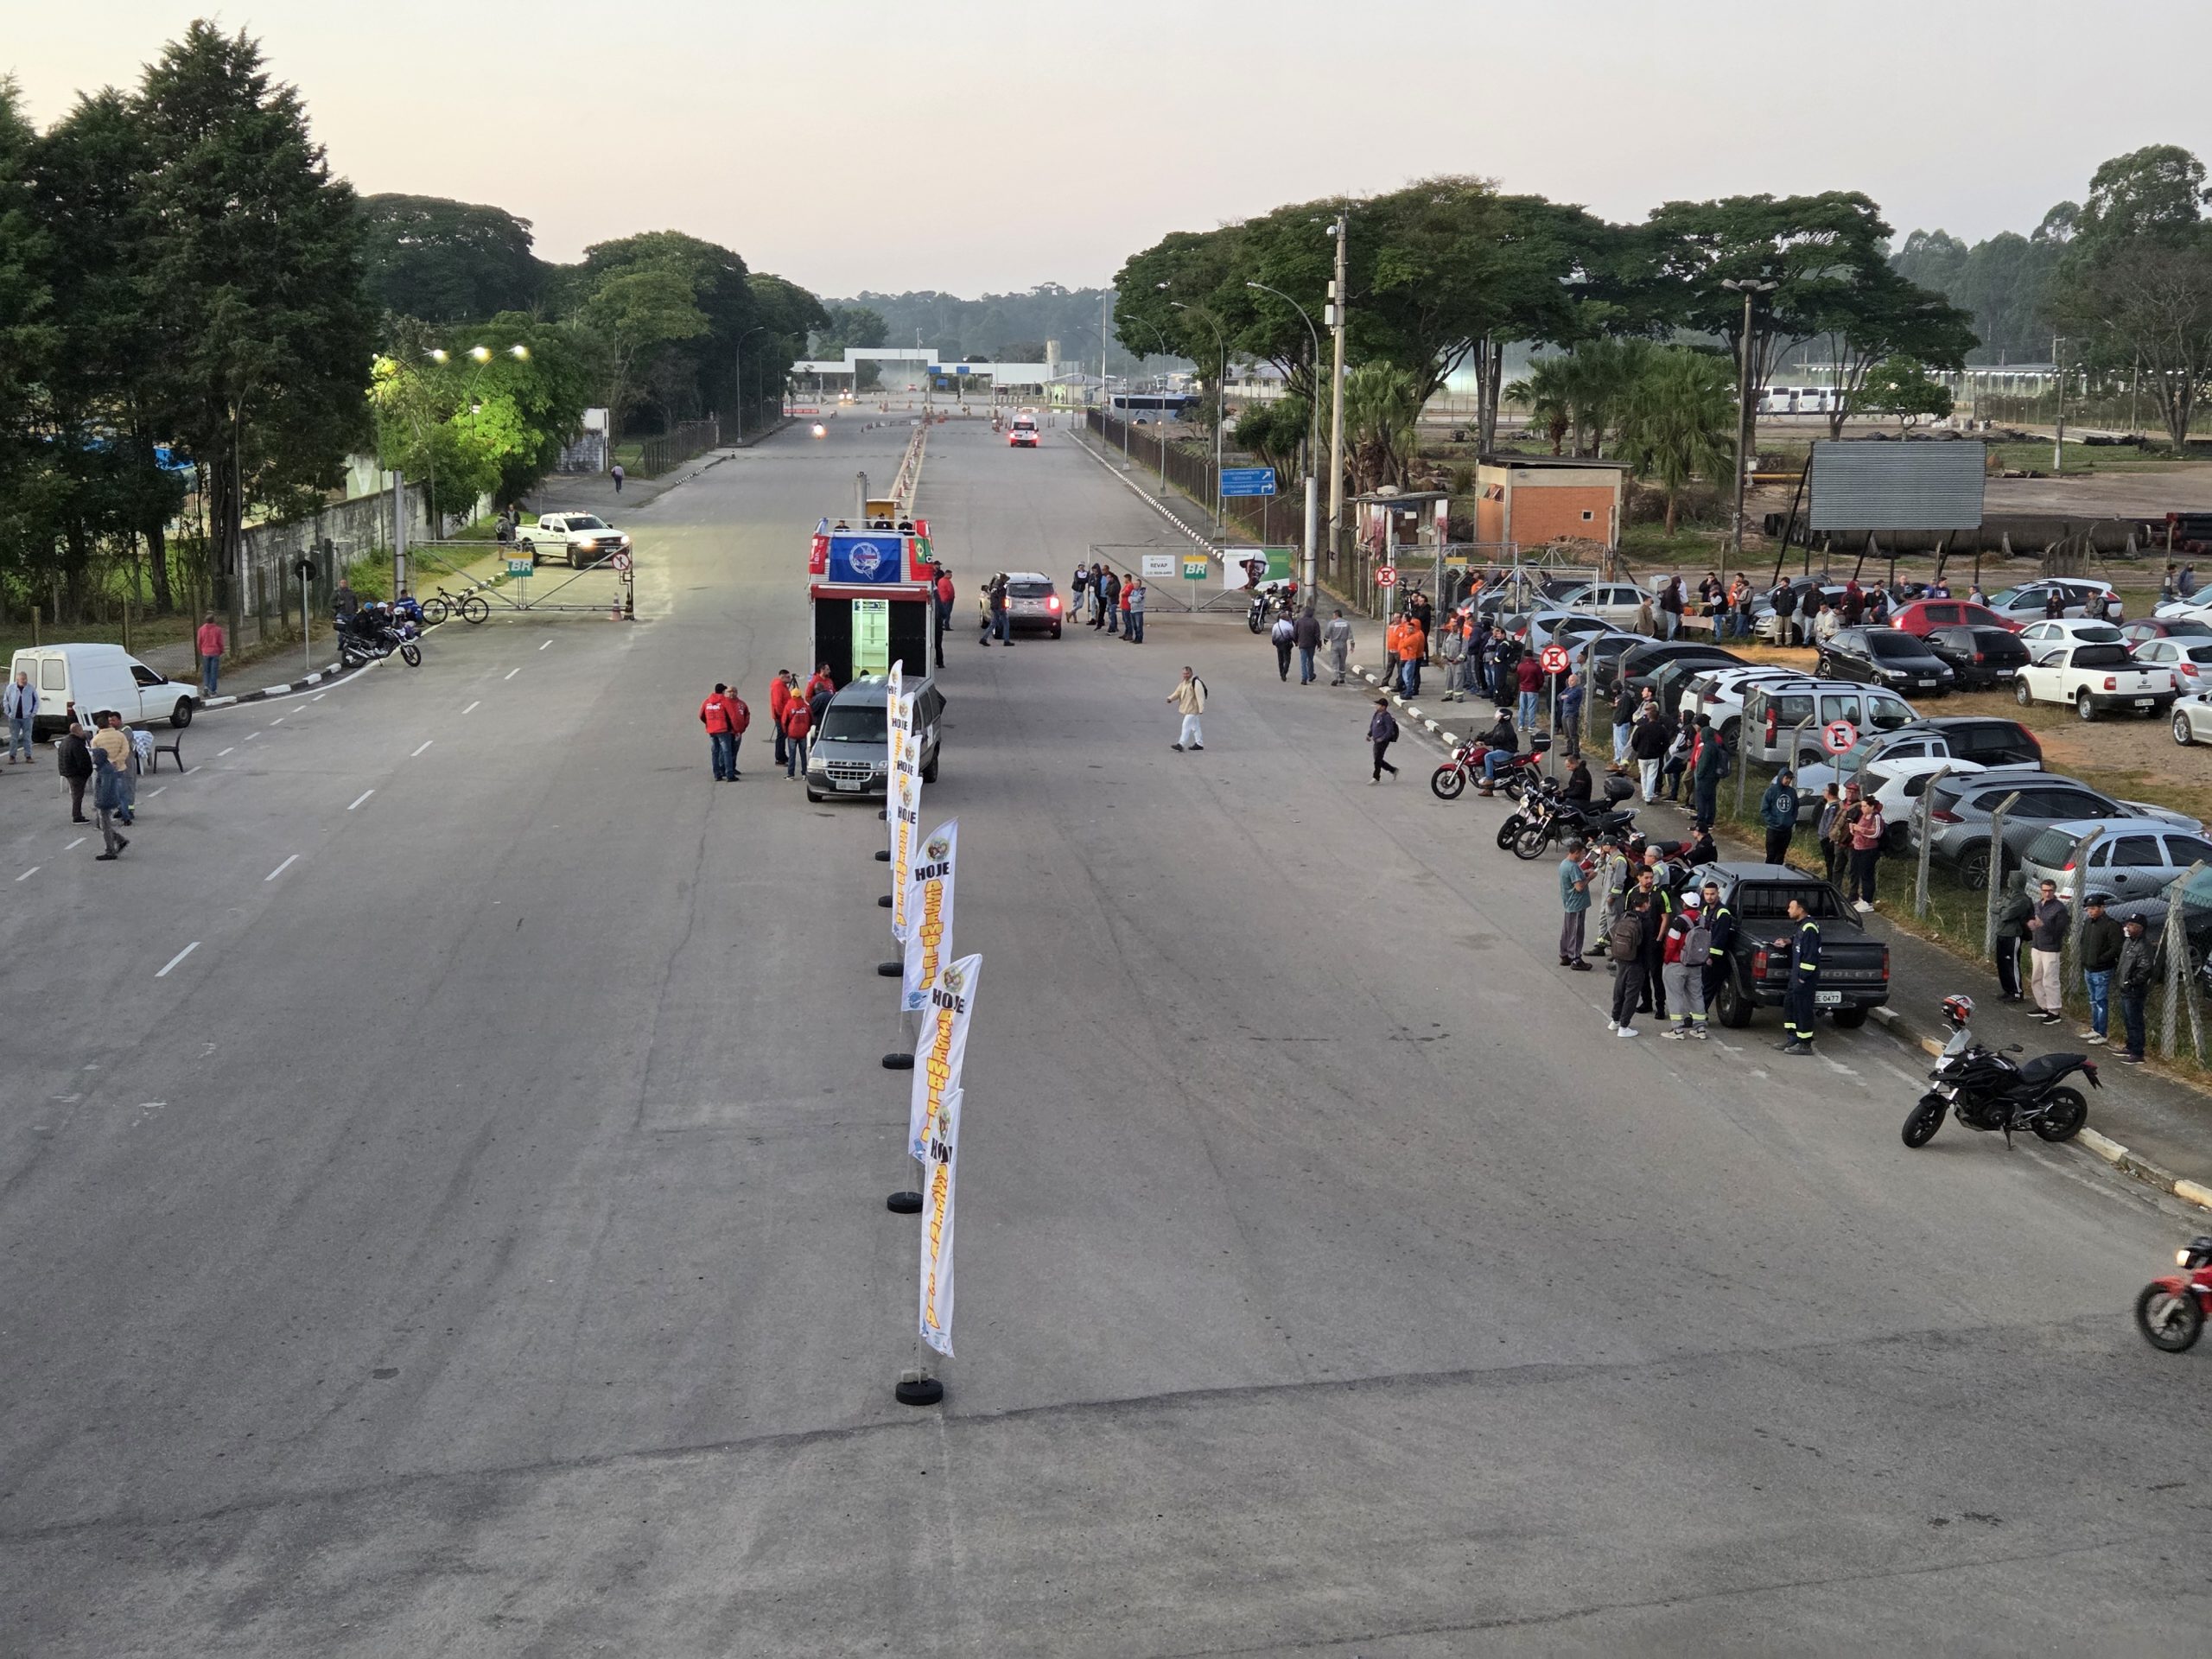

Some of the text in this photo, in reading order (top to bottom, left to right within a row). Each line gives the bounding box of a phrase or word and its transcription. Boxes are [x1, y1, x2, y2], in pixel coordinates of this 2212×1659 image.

[511, 561, 531, 571] BR
[1185, 563, 1205, 574] BR
[892, 718, 908, 731] HOJE
[897, 760, 914, 776] HOJE
[898, 806, 916, 824] HOJE
[914, 861, 950, 881] HOJE
[918, 879, 944, 990] ASSEMBLEIA
[932, 988, 965, 1014] HOJE
